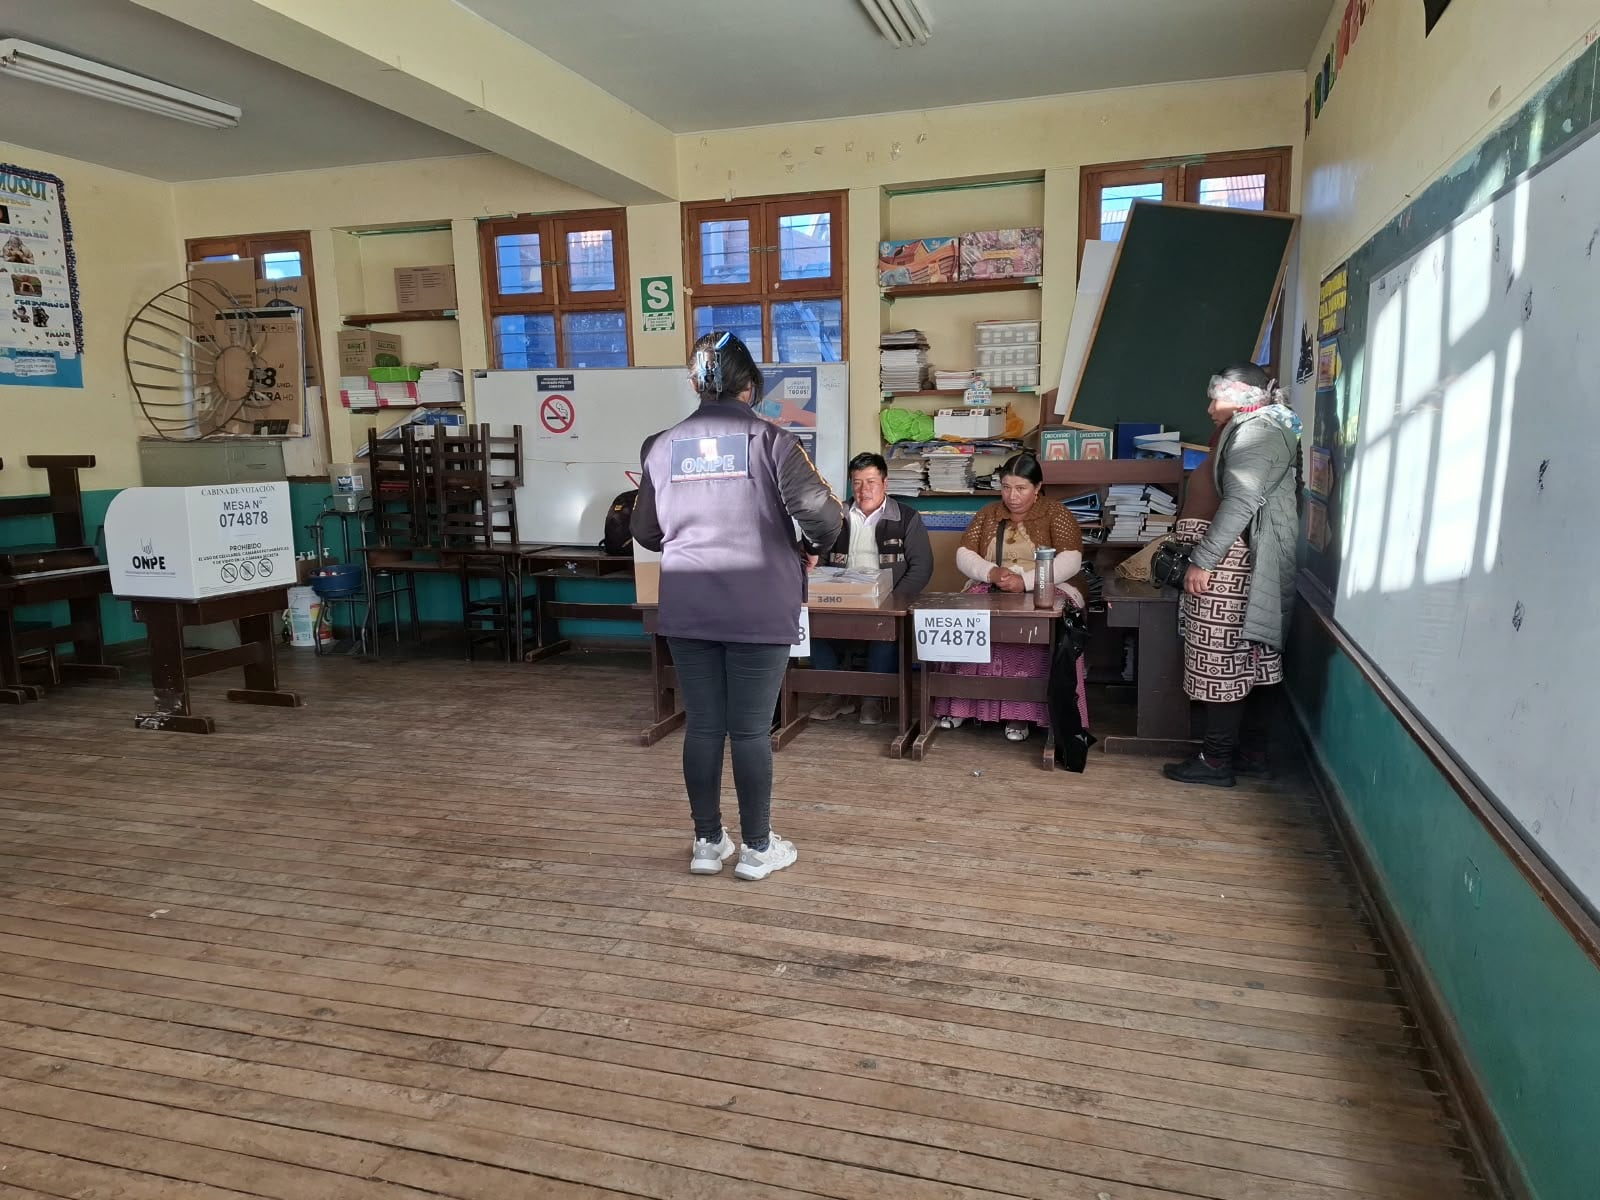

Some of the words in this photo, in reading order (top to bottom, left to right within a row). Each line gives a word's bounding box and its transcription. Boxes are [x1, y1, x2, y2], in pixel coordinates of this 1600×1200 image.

[647, 281, 669, 309] S
[681, 455, 735, 473] ONPE
[224, 501, 250, 511] MESA
[220, 511, 268, 527] 074878
[230, 543, 262, 551] PROHIBIDO
[132, 556, 166, 570] ONPE
[925, 617, 963, 627] MESA
[918, 630, 987, 646] 074878
